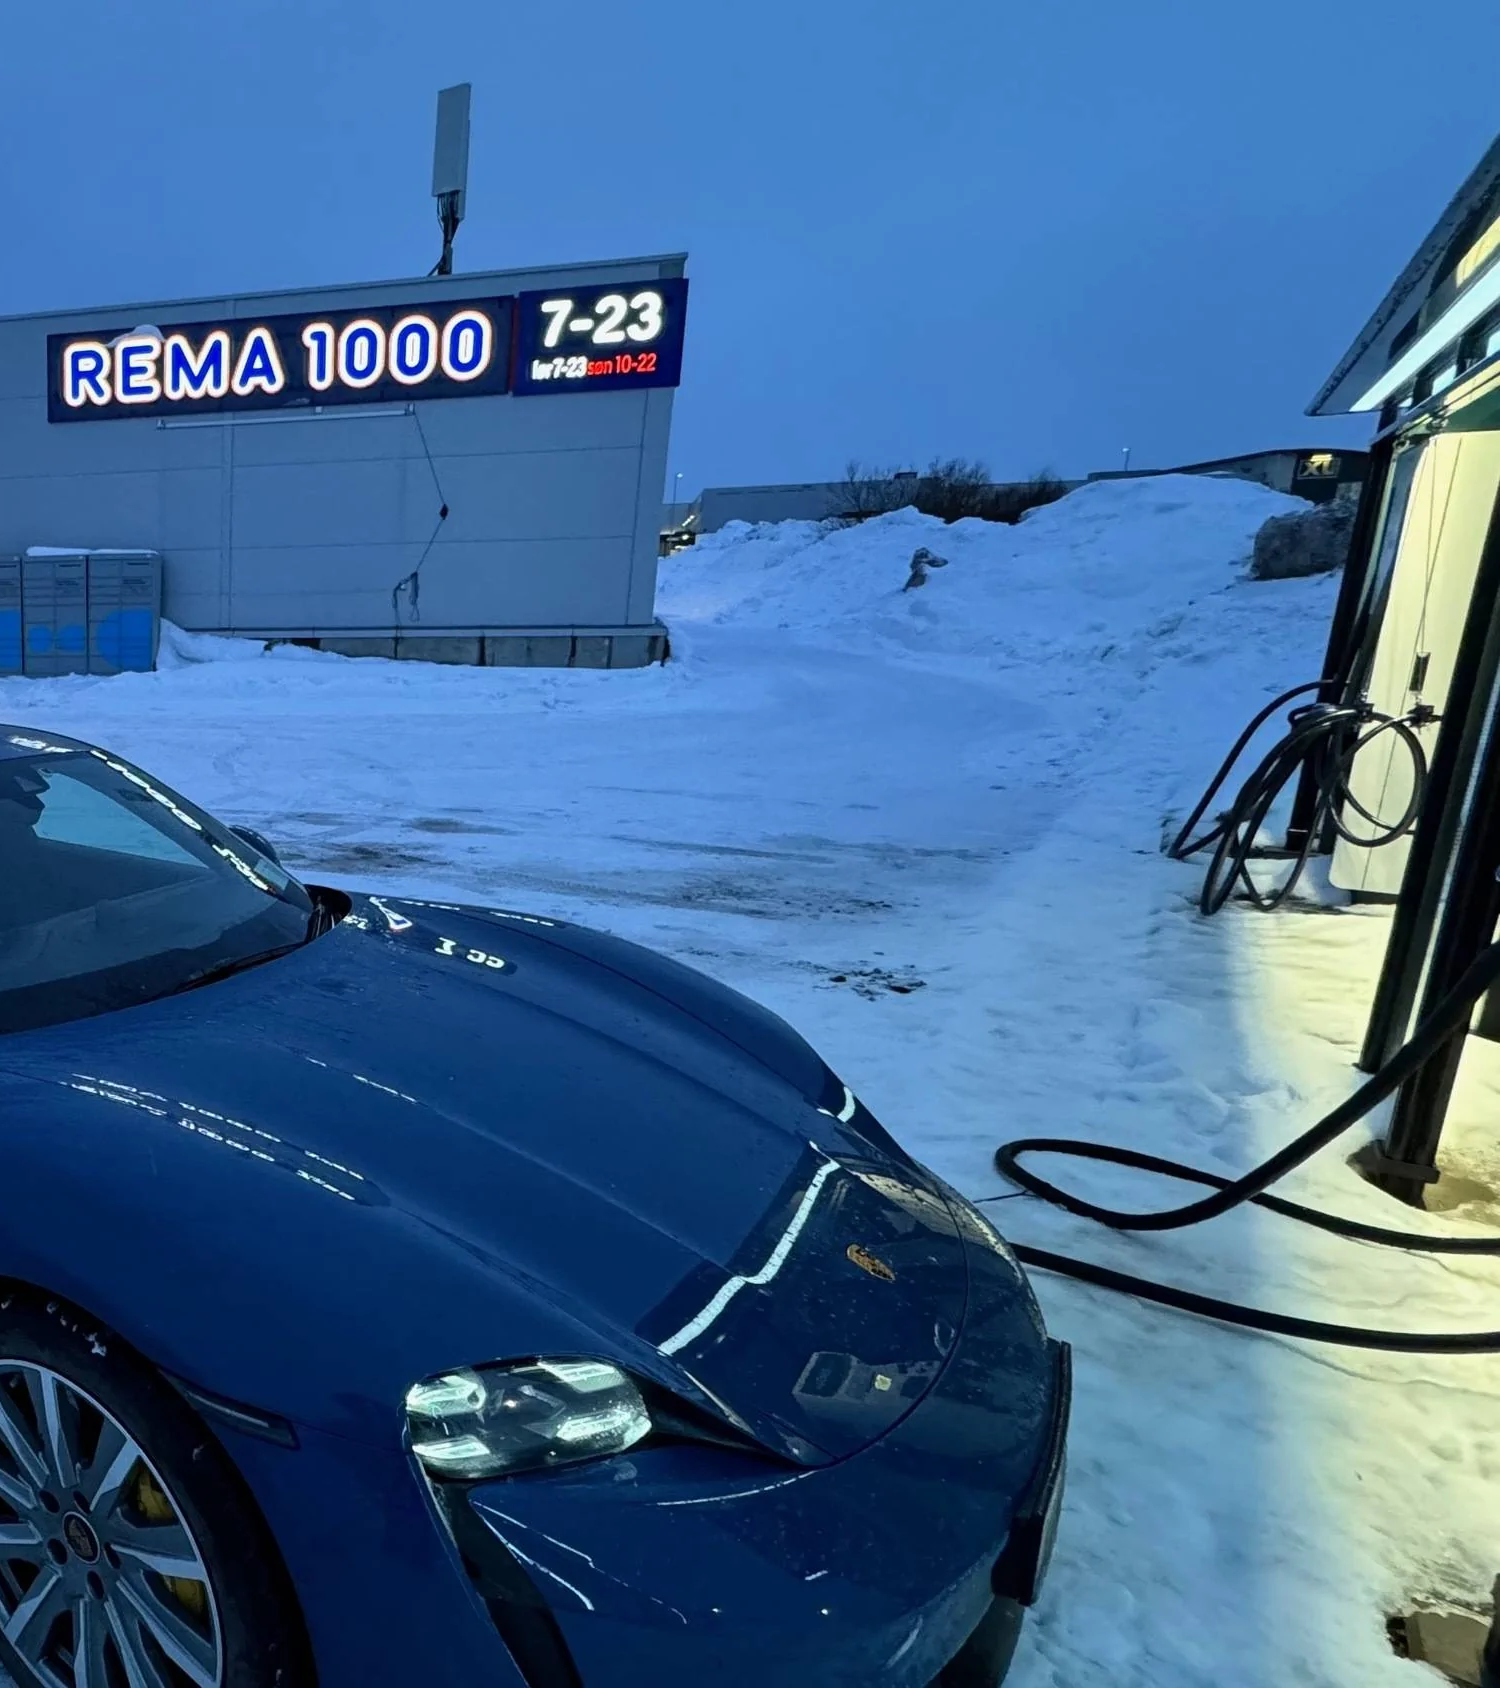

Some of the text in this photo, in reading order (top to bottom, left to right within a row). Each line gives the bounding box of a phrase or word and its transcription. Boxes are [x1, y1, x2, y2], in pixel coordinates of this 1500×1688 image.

[541, 291, 662, 348] 7-23
[63, 310, 492, 408] REMA 1000
[615, 353, 657, 373] 10-22
